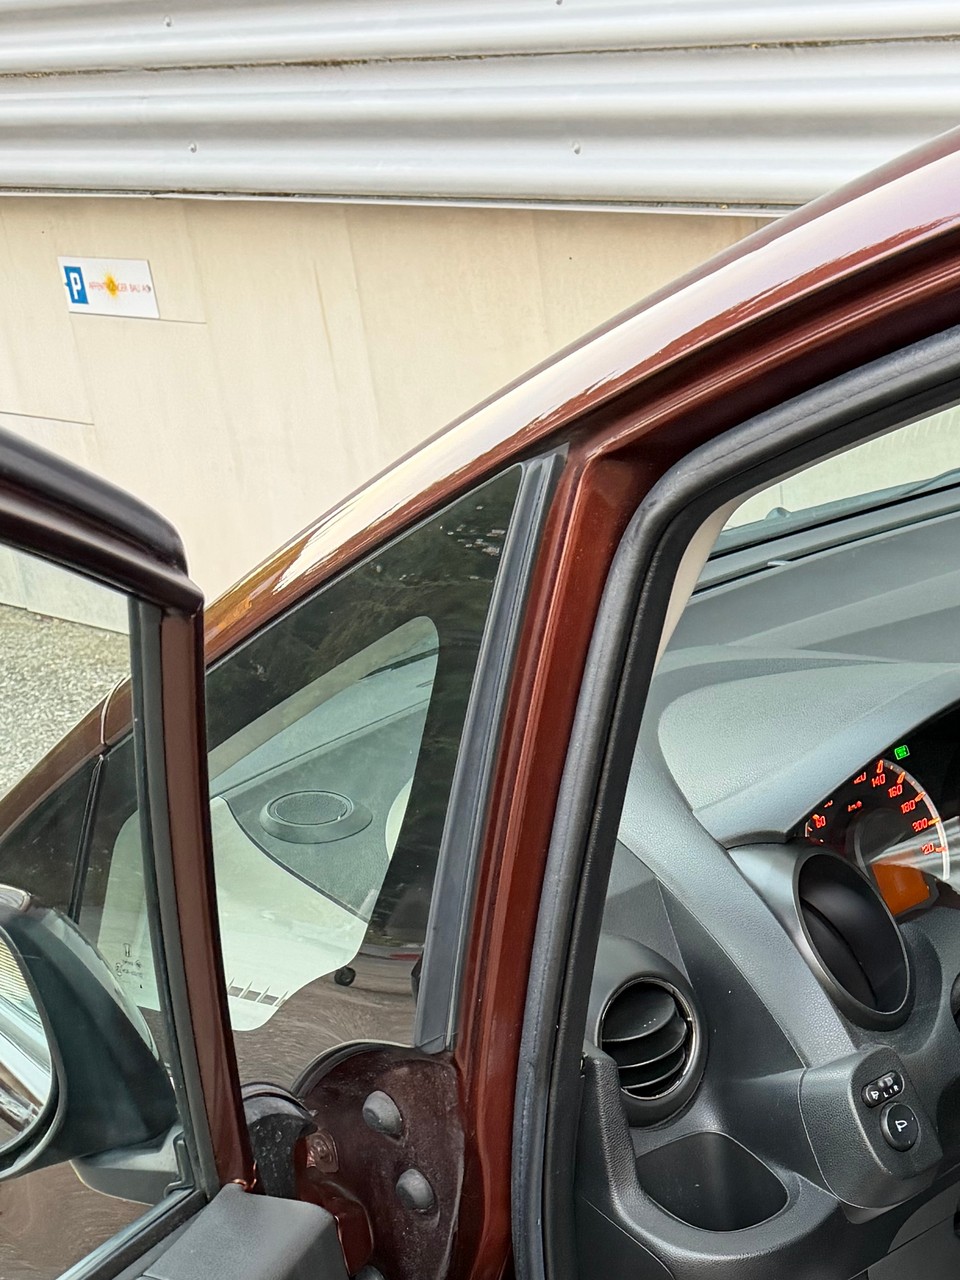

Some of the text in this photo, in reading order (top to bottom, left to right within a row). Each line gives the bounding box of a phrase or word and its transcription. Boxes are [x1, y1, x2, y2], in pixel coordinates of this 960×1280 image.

[70, 272, 81, 300] P
[871, 773, 886, 788] 140
[888, 784, 903, 799] 160
[901, 800, 916, 814] 180
[912, 817, 928, 832] 200
